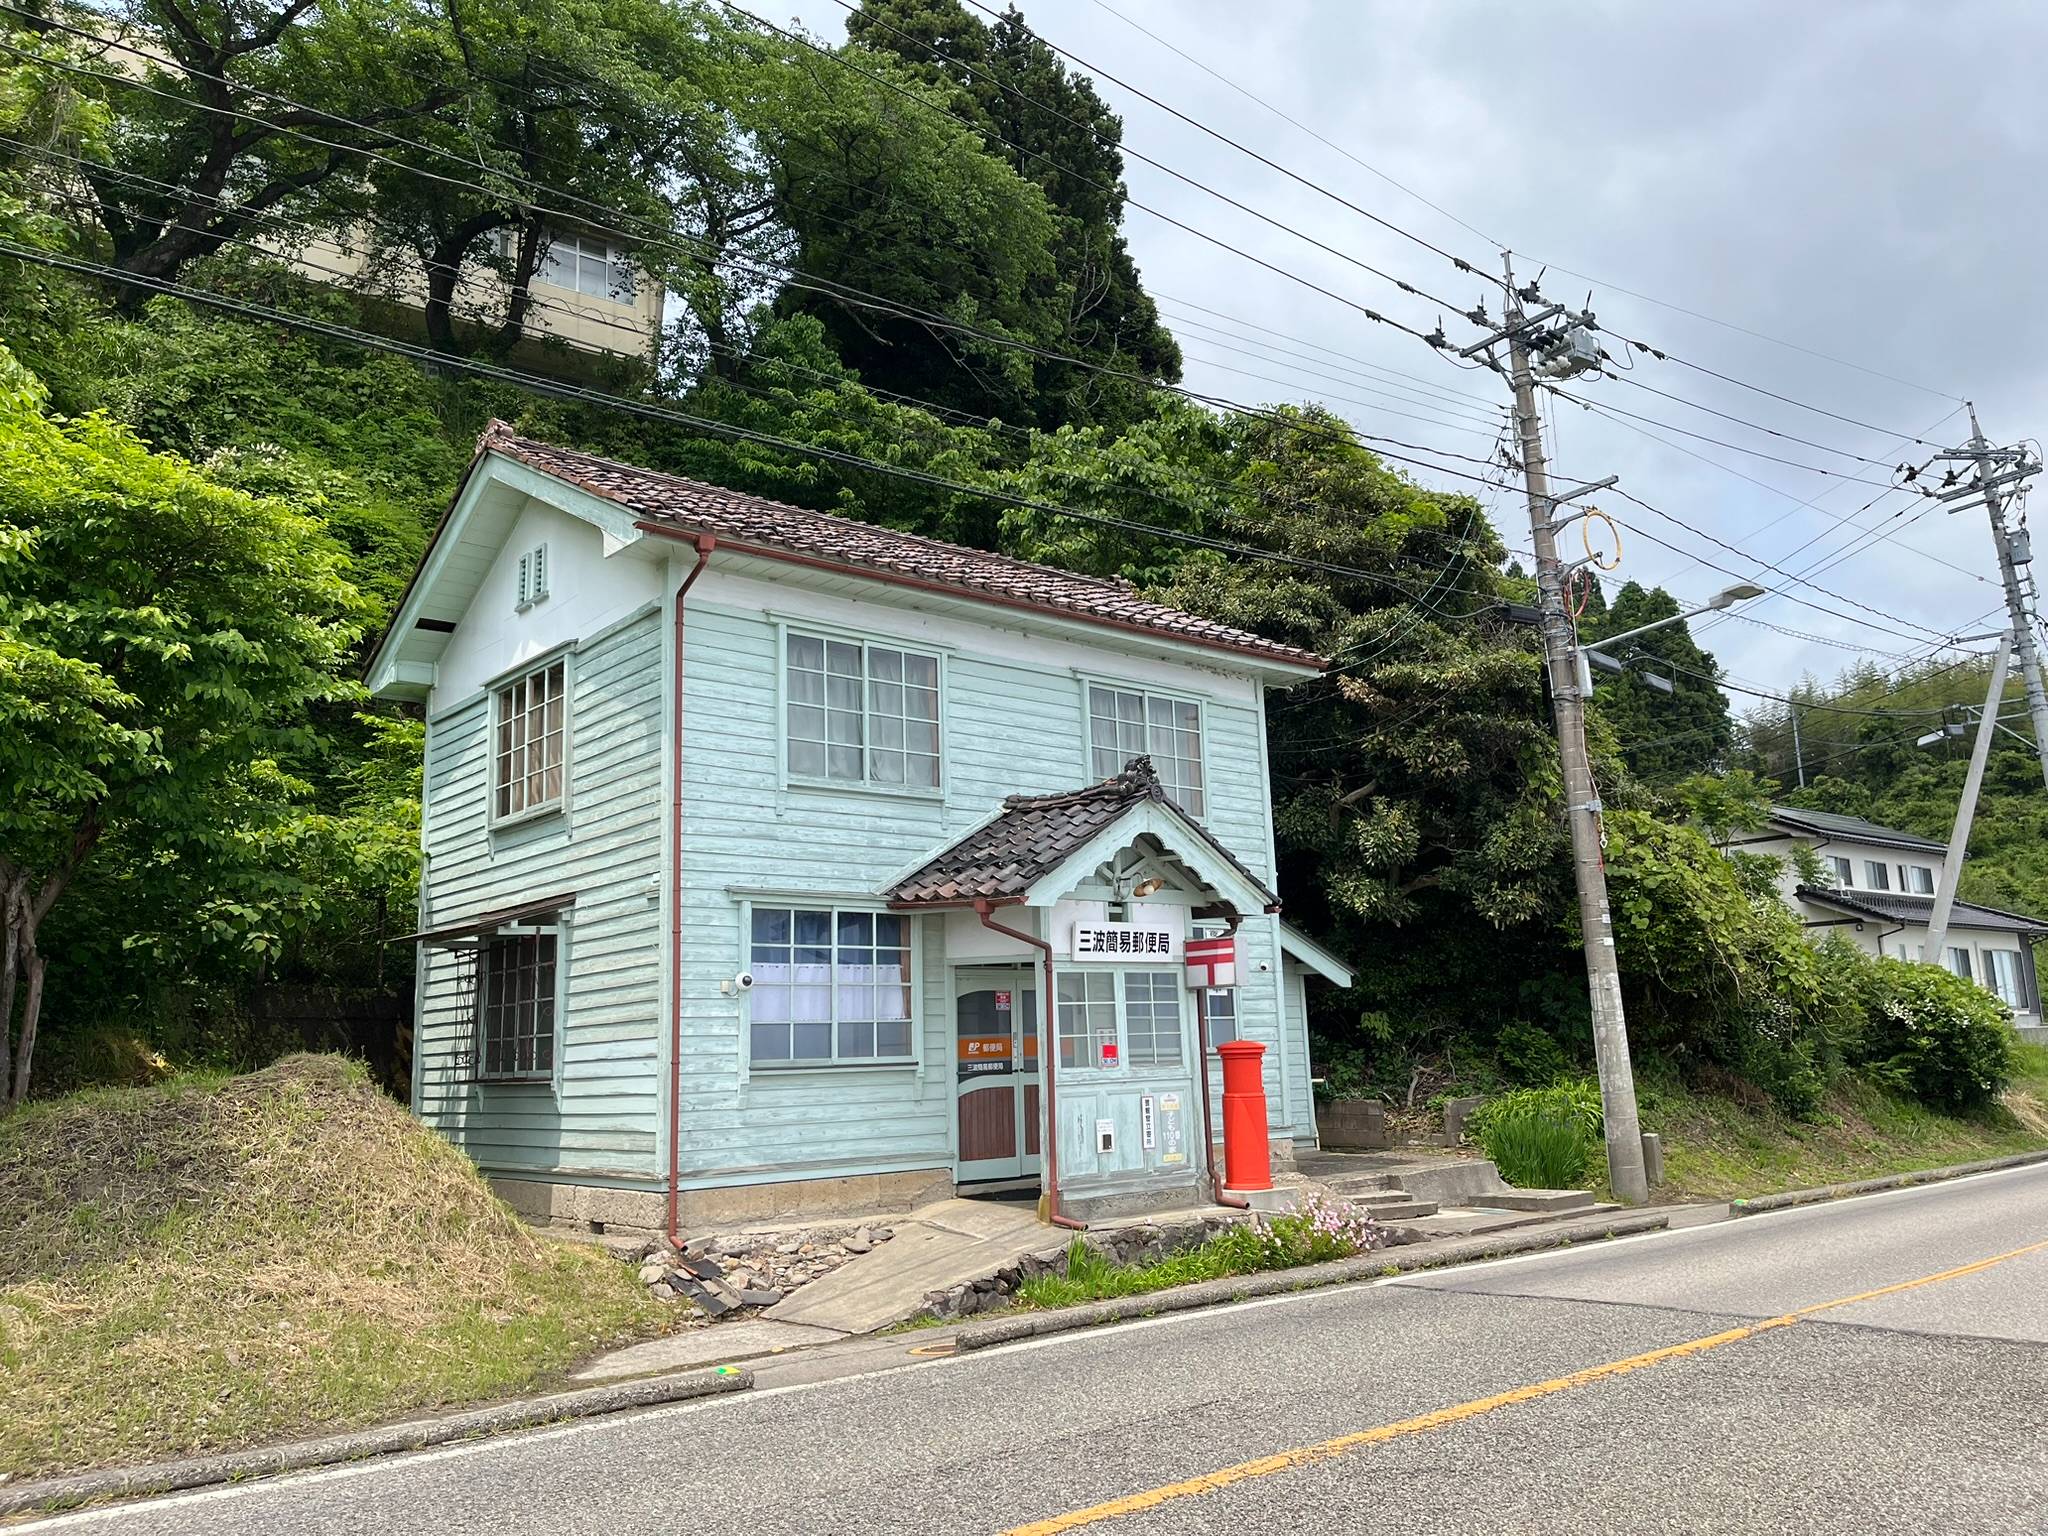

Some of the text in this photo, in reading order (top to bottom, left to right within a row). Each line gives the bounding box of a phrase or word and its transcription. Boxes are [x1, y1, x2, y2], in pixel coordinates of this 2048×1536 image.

[1079, 930, 1170, 954] 三波簡易郵便局
[983, 1043, 1003, 1053] 郵便局
